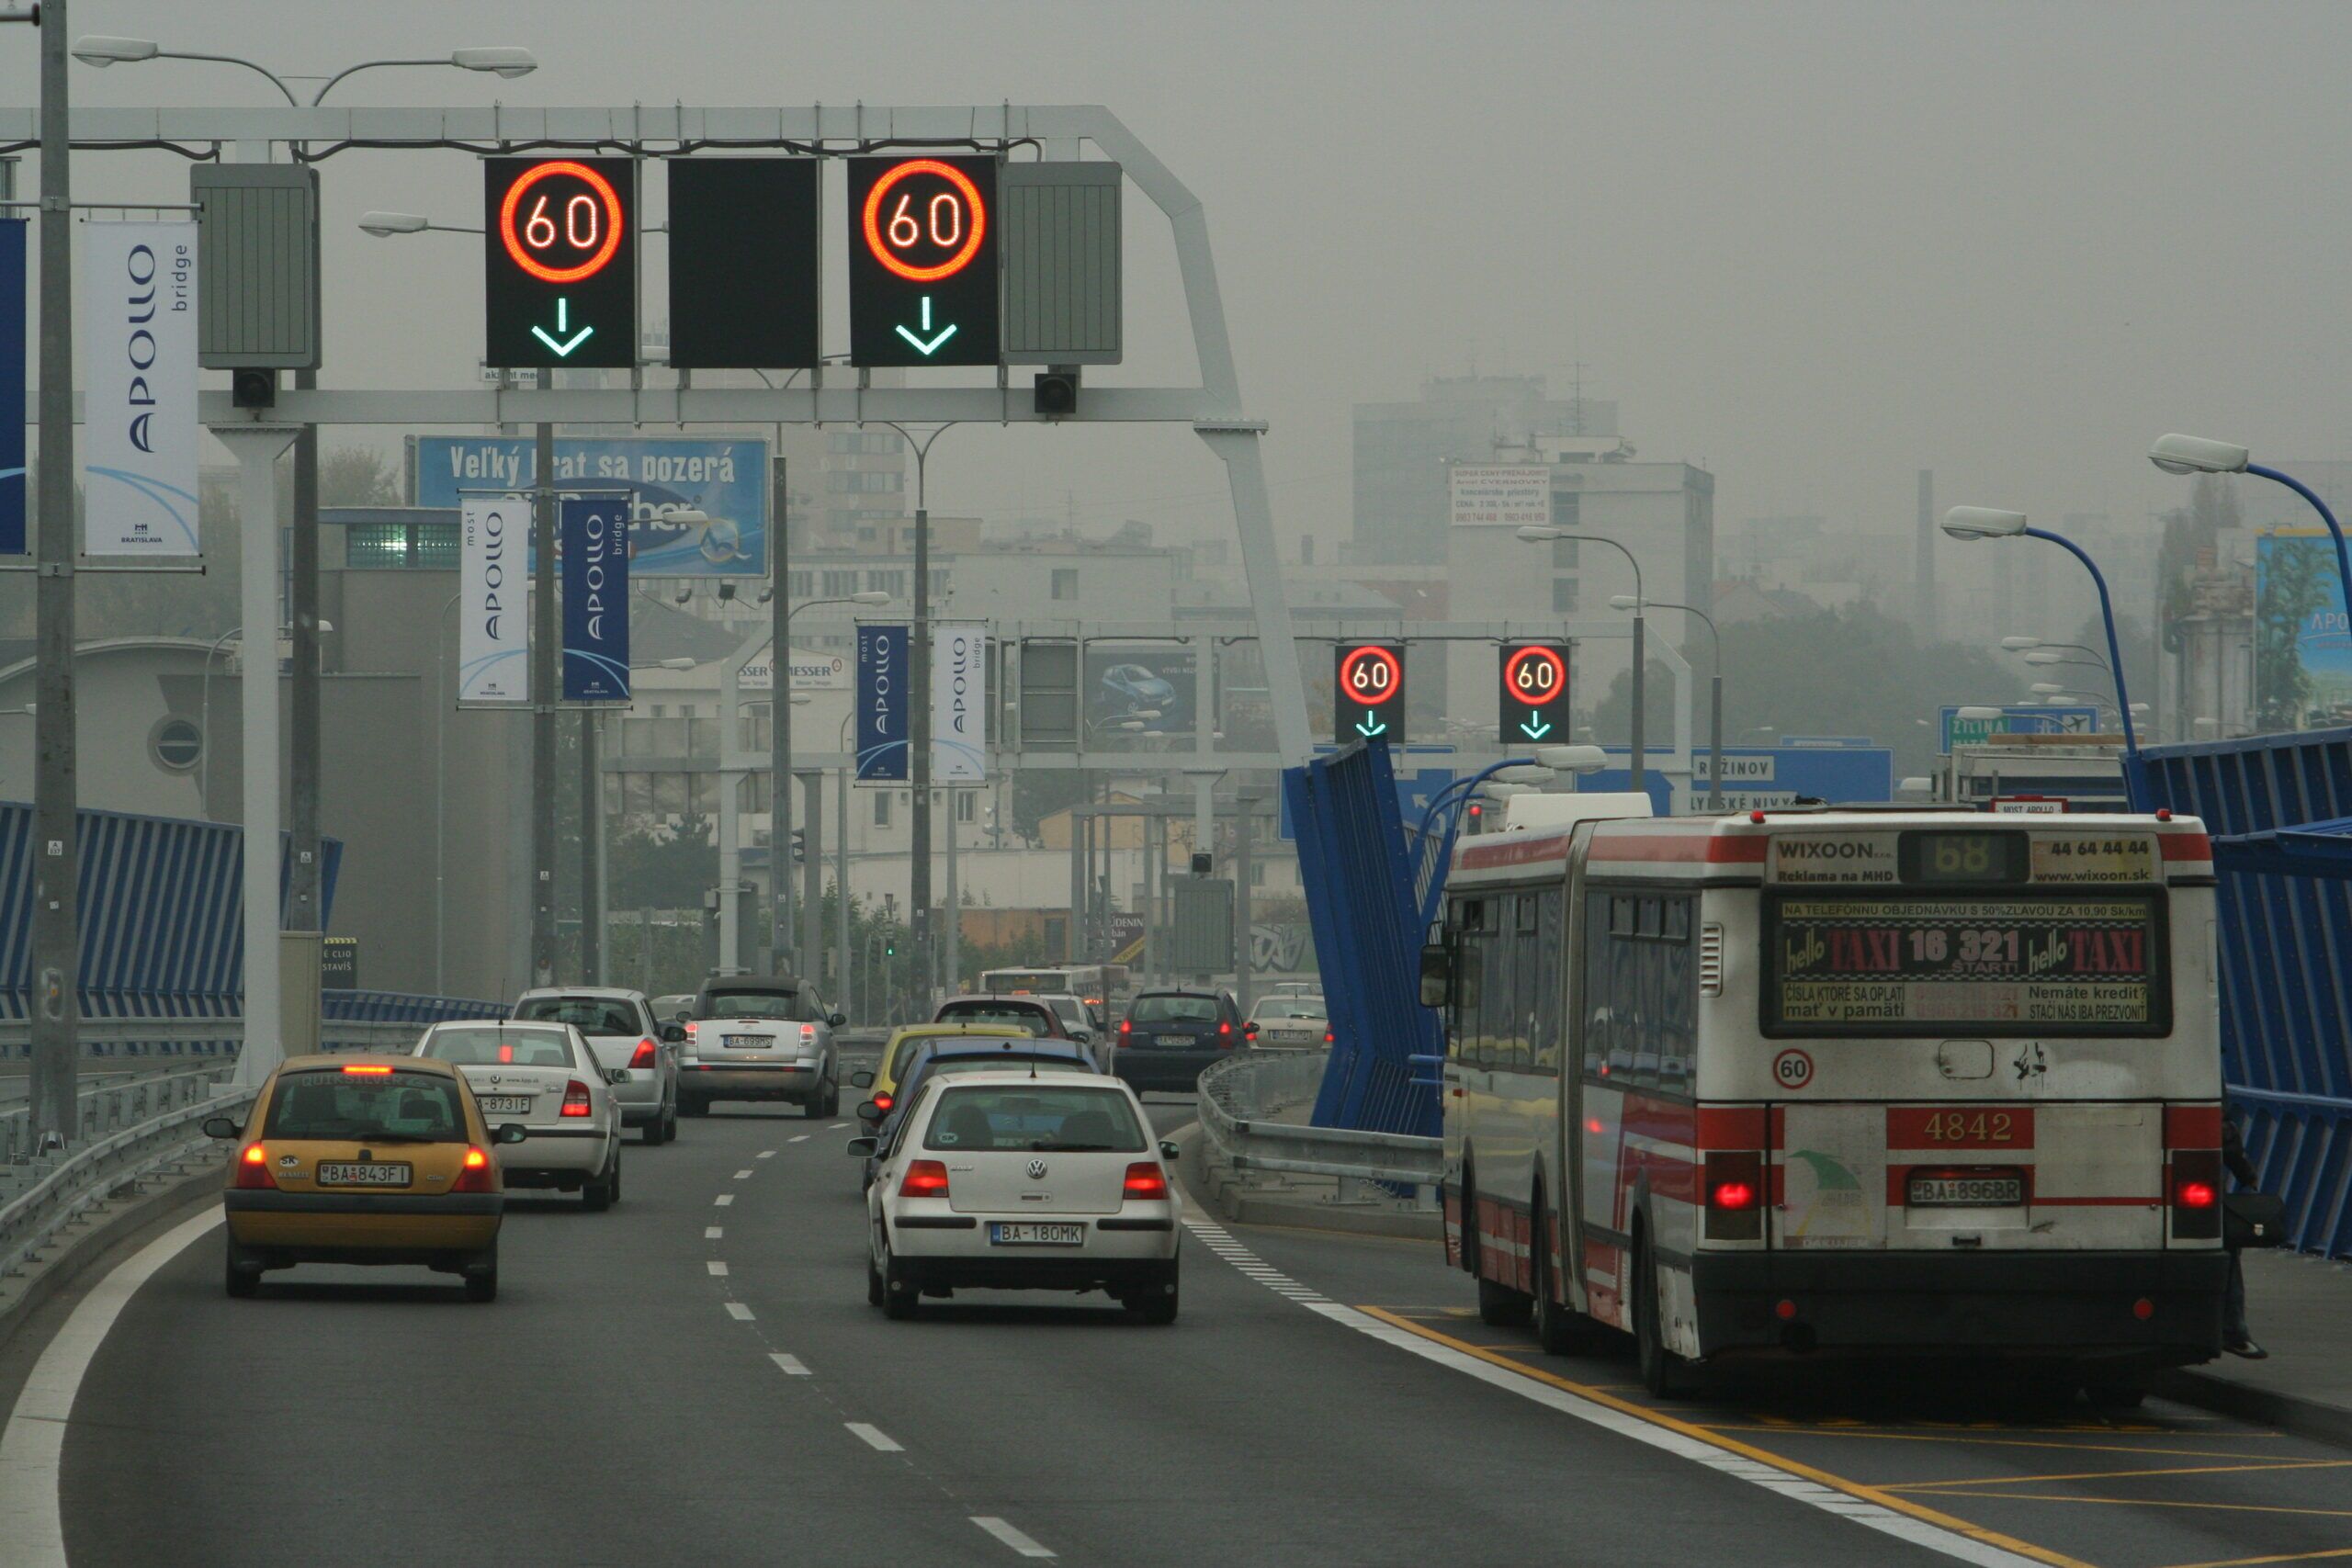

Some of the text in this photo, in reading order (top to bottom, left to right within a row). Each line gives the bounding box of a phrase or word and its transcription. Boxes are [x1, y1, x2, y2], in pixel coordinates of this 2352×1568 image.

[526, 194, 597, 250] 60
[888, 193, 961, 249] 60
[171, 244, 192, 312] bridge
[127, 243, 156, 454] APOLLO
[450, 446, 520, 487] Veľký
[598, 455, 630, 479] sa
[643, 446, 735, 483] pozerá
[466, 512, 475, 547] most
[612, 513, 626, 556] bridge
[485, 512, 503, 640] APOLLO
[586, 514, 605, 640] APOLLO
[973, 637, 983, 669] bridge
[876, 635, 890, 735] APOLLO
[953, 637, 967, 733] APOLLO
[1353, 662, 1388, 689] 60
[1518, 662, 1554, 689] 60
[1699, 758, 1768, 775] RŽINOV
[1778, 841, 1873, 859] WIXOON
[1935, 835, 1990, 873] 68
[2051, 840, 2149, 856] 44 64 44 44
[1778, 870, 1894, 883] Reklama na MHD
[2035, 868, 2150, 883] www.wixoon.sk
[1784, 905, 1804, 916] NA
[1805, 903, 1880, 916] TELEFÓNNU
[1883, 903, 1967, 916] OBJEDNÁVKU
[1970, 905, 1979, 916] S
[2057, 906, 2075, 916] ZA
[2109, 906, 2146, 917] Sk/km
[332, 950, 352, 958] CLIO
[1786, 927, 2143, 975] hello TAXI 16 321 hello TAXI
[1785, 986, 1815, 1002] ČÍSLA
[1816, 985, 1851, 1002] KTORÉ
[1853, 987, 1868, 1002] SA
[2029, 985, 2146, 999] Nemáte kredit?
[1785, 1002, 1905, 1021] mať v pamäti
[2029, 1001, 2056, 1020] STAČÍ
[2057, 1002, 2076, 1020] NÁS
[2077, 1004, 2094, 1020] IBA
[301, 1074, 403, 1087] QUIKSILVER
[1780, 1059, 1806, 1078] 60
[941, 1134, 956, 1142] SK
[1923, 1112, 2012, 1142] 4842
[280, 1155, 297, 1165] SK
[1001, 1225, 1080, 1241] BA-180MK
